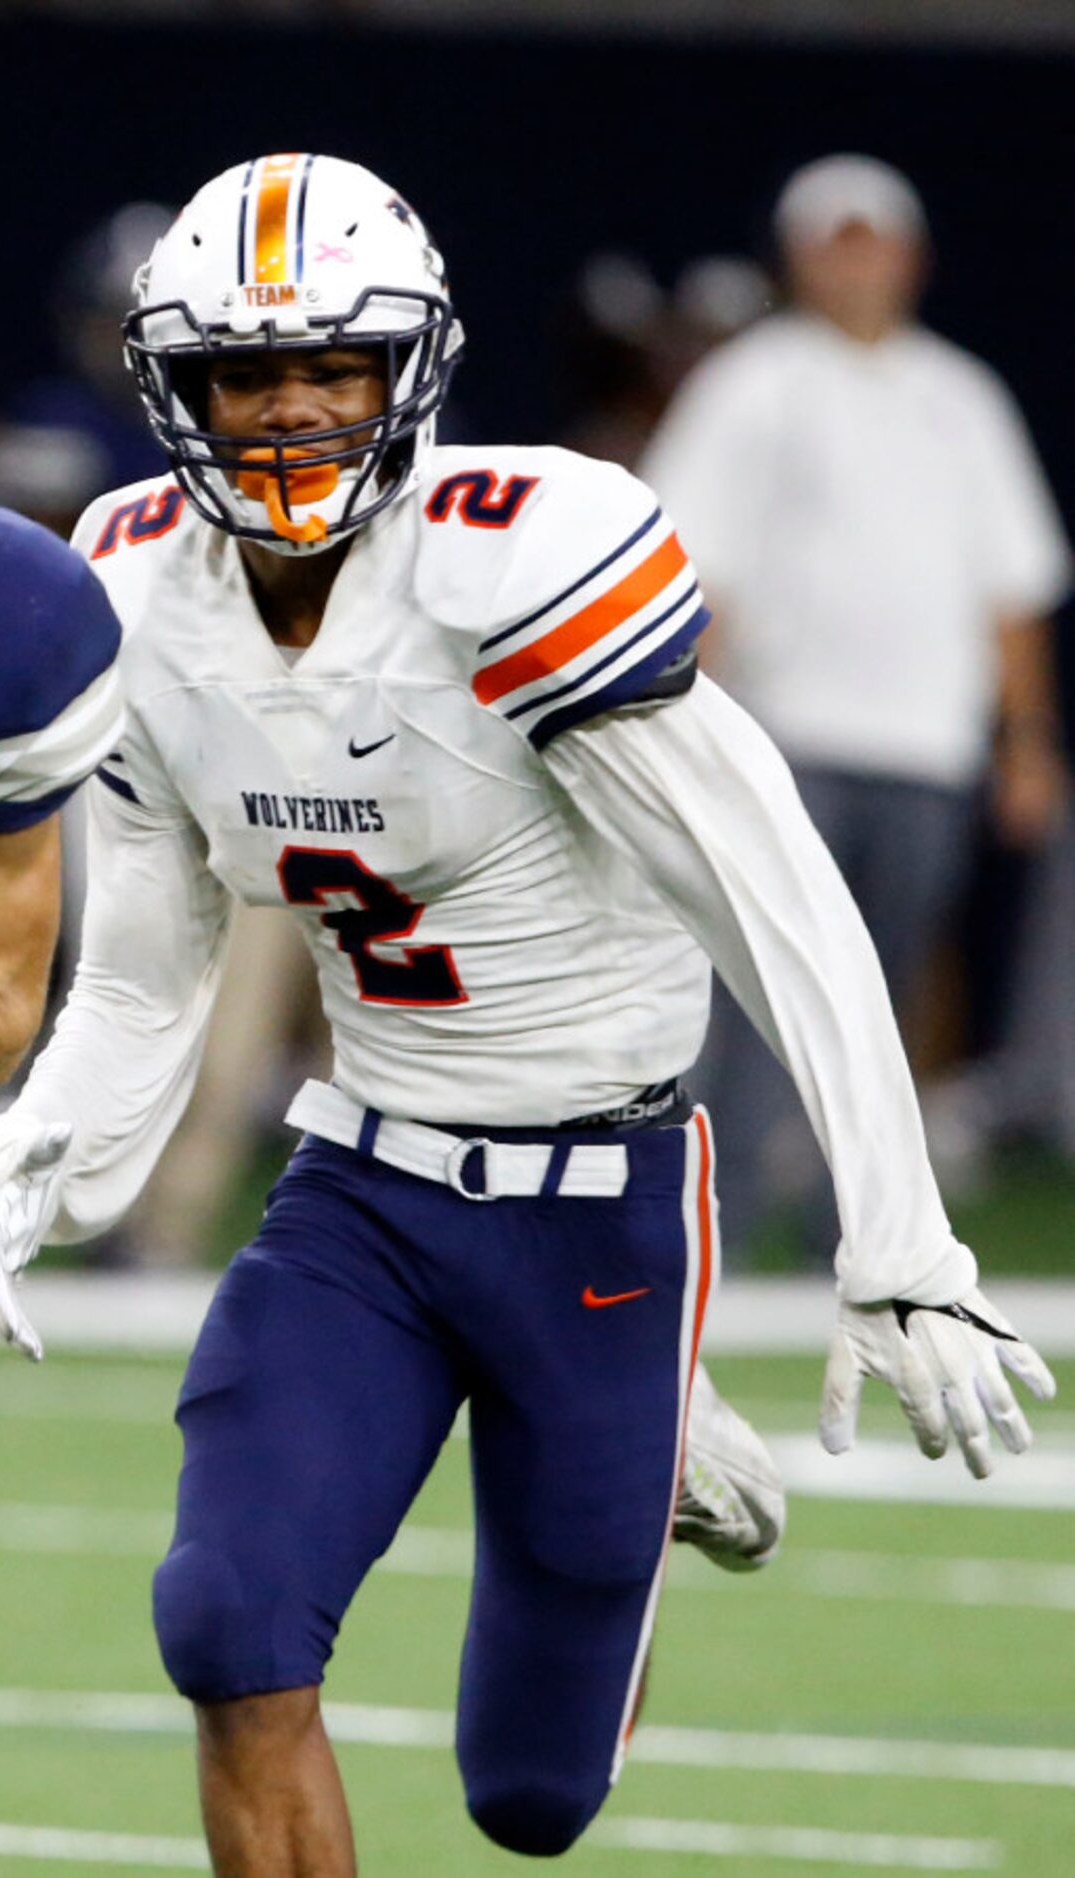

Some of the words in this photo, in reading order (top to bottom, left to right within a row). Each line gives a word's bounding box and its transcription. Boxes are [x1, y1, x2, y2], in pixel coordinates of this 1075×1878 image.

[243, 285, 297, 307] TEAM
[89, 486, 186, 560] 2
[426, 469, 540, 530] 2
[241, 791, 385, 833] WOLVERINES
[276, 845, 470, 1007] 2
